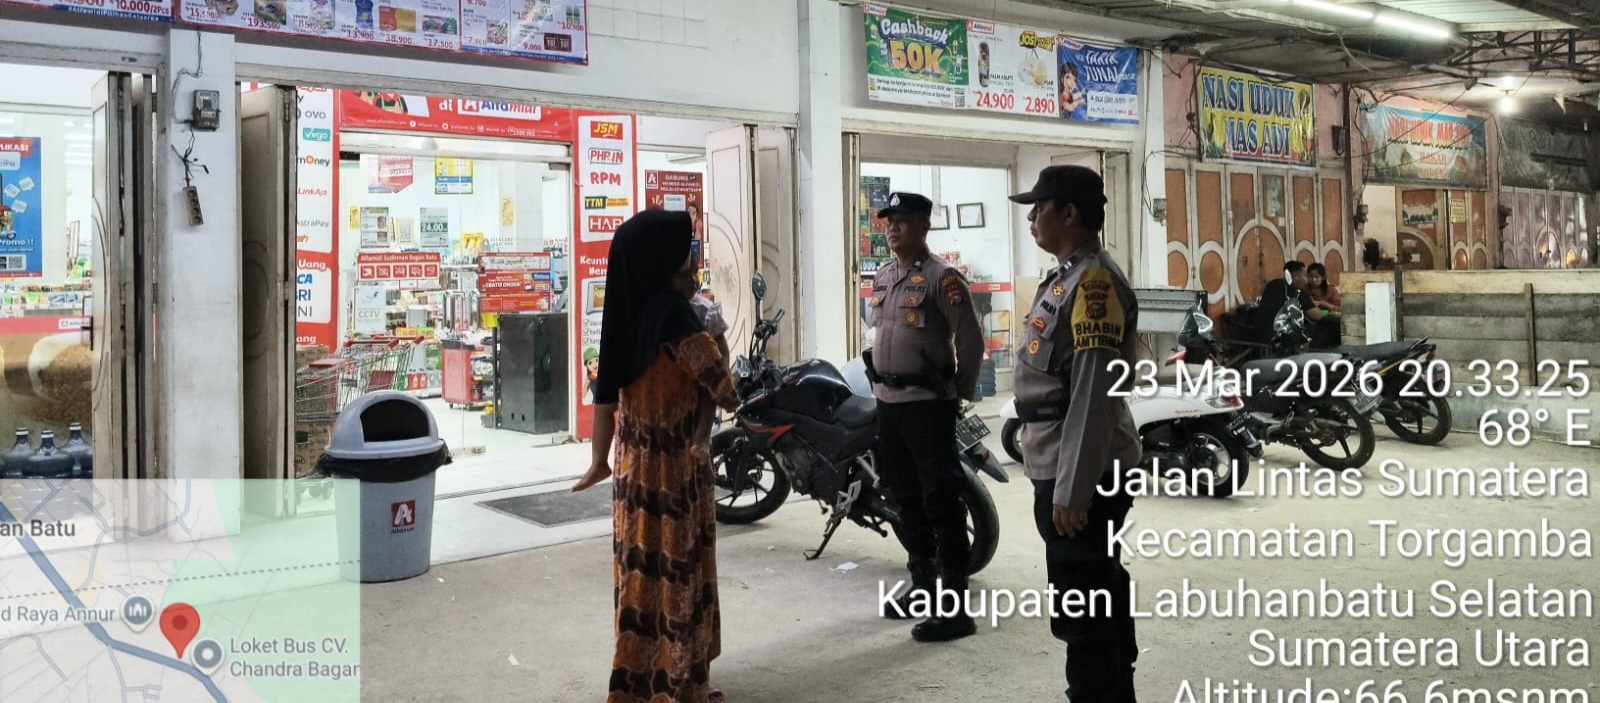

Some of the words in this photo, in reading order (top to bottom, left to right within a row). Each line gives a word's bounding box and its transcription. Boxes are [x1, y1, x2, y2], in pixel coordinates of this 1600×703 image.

[881, 18, 948, 44] Cashback
[889, 40, 944, 75] 50K
[976, 91, 1014, 110] 24.900
[1202, 73, 1245, 112] NASI
[1248, 81, 1296, 118] UDUK
[438, 99, 453, 112] di
[1025, 96, 1055, 114] 2.890
[594, 122, 618, 134] JSM
[305, 129, 327, 141] Virgo
[1262, 122, 1292, 158] ADI
[590, 171, 621, 186] RPM
[585, 198, 603, 208] TTM
[297, 219, 329, 229] straPay
[298, 259, 326, 271] Uang
[296, 273, 313, 285] CA
[296, 289, 311, 301] RI
[297, 306, 312, 317] NI
[358, 310, 380, 318] CCTV
[1075, 321, 1121, 337] BHABIN
[296, 334, 316, 344] ang
